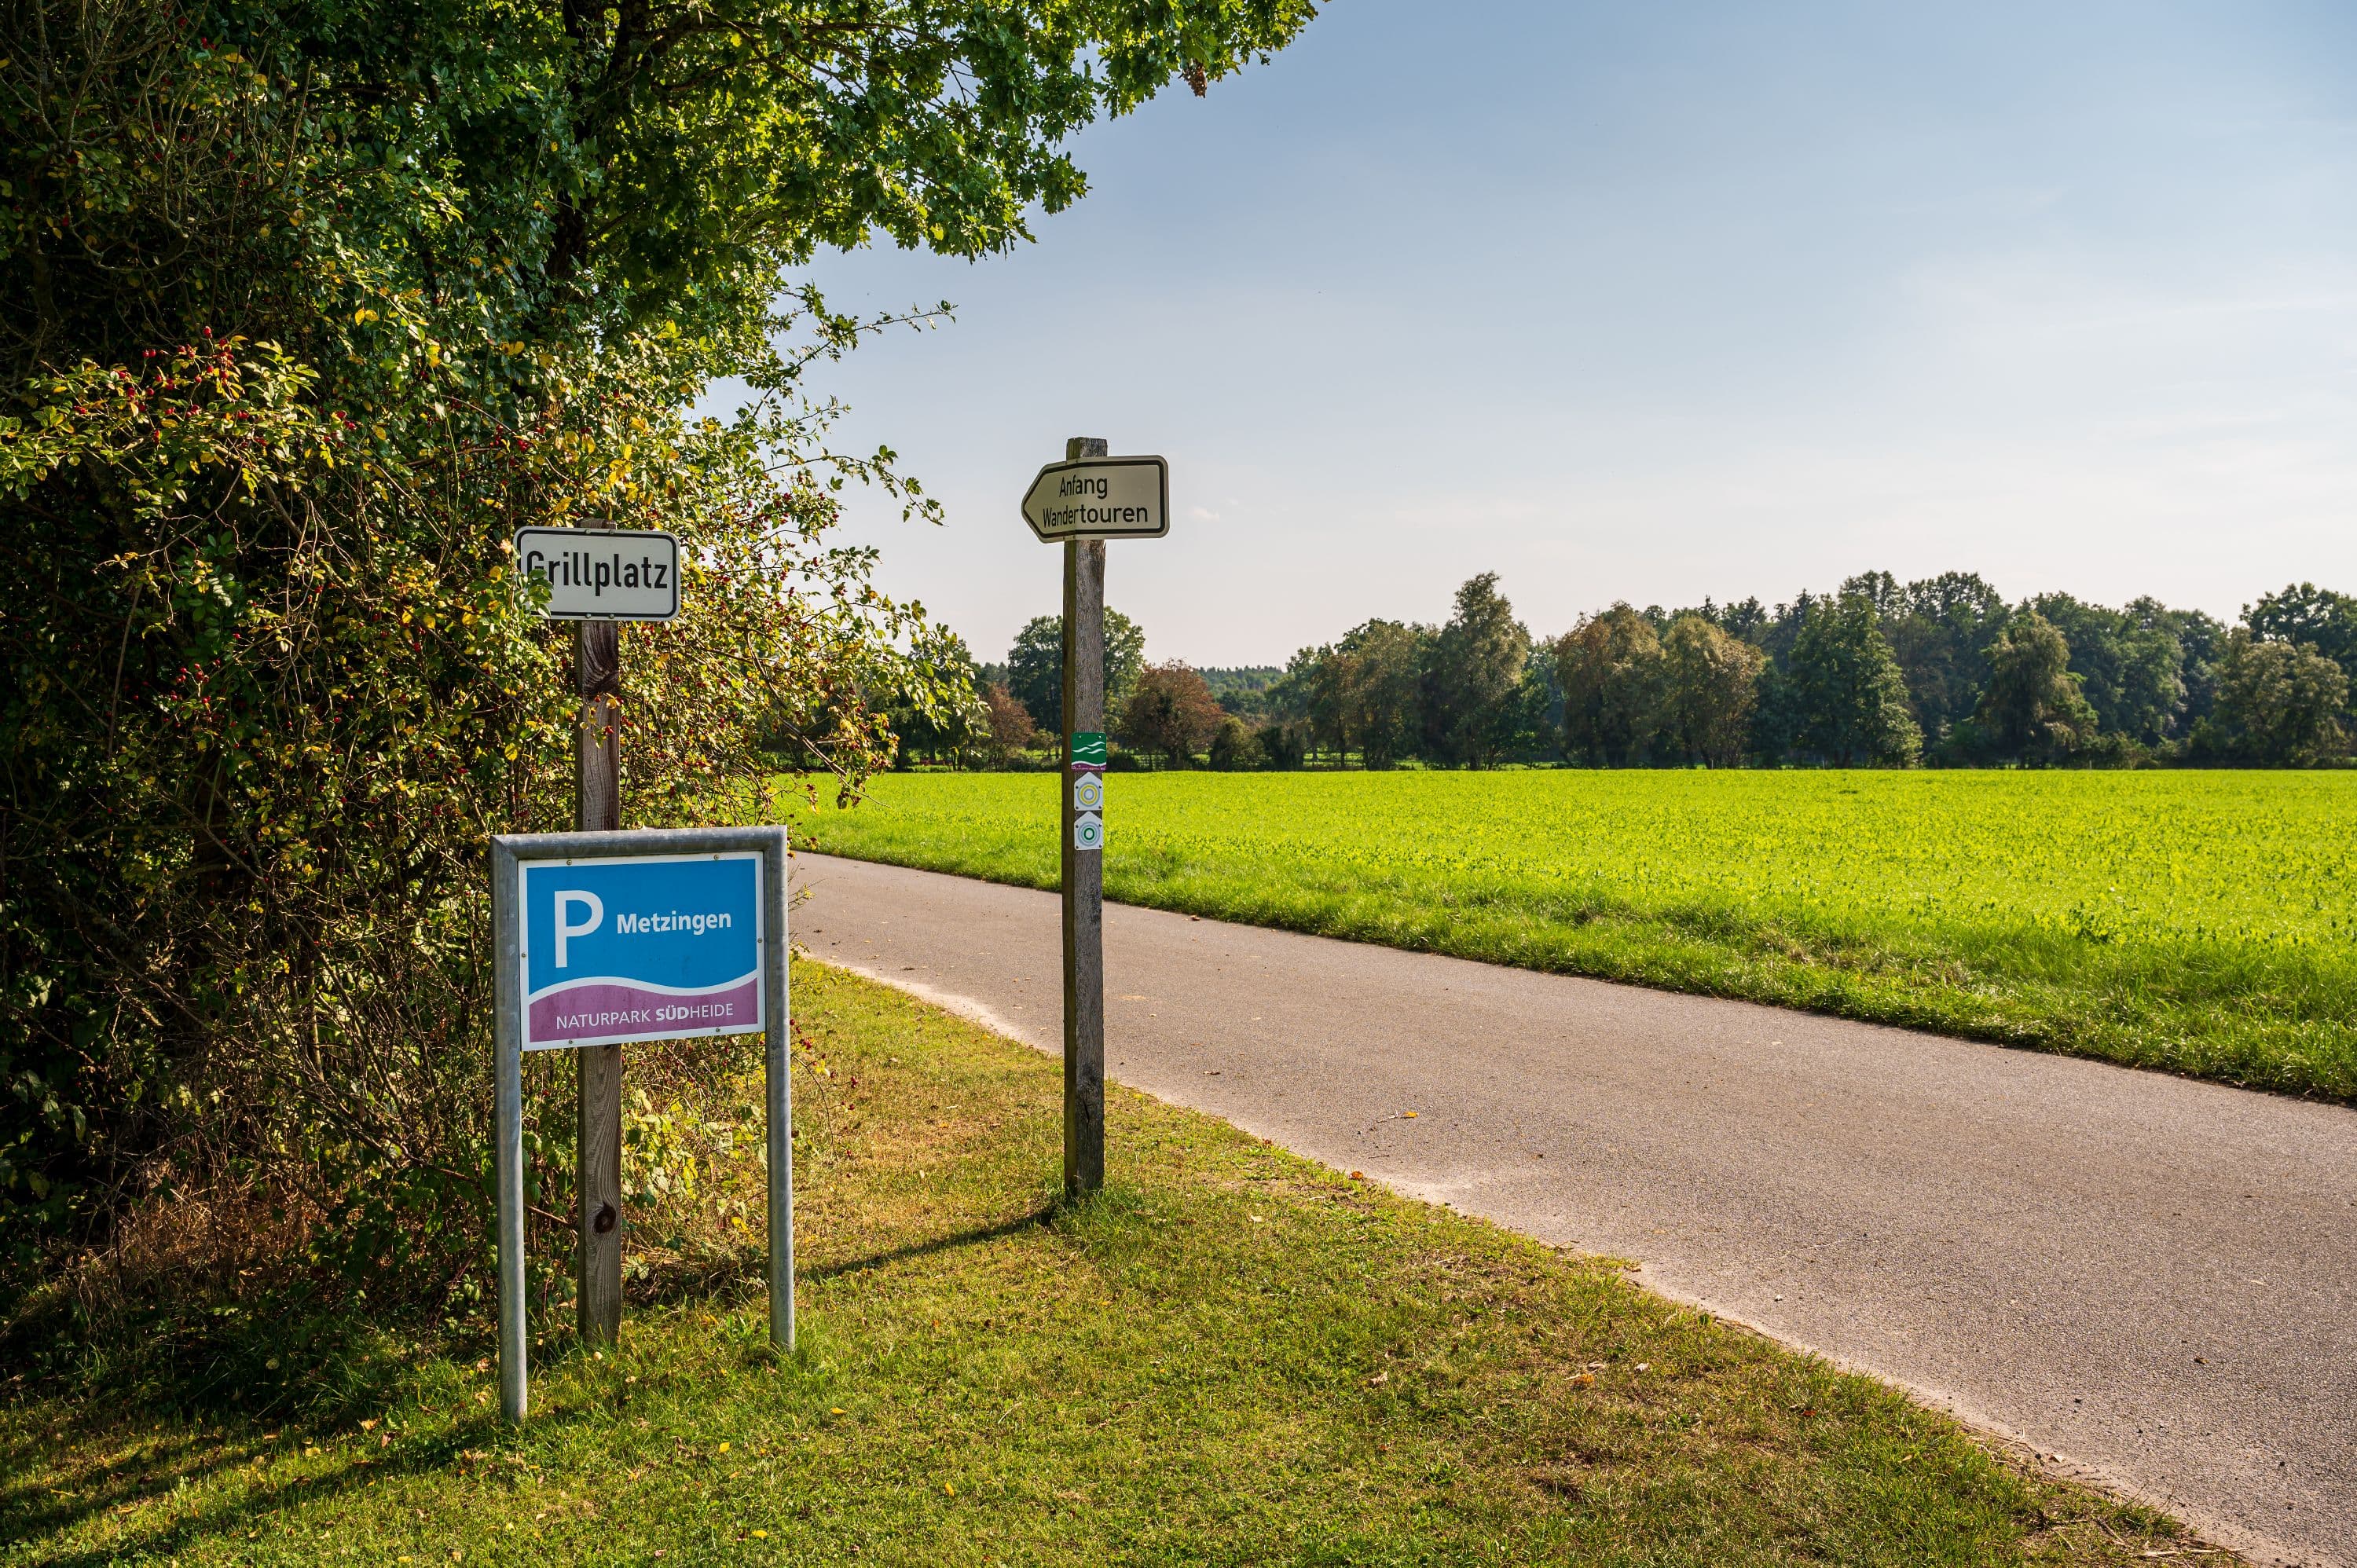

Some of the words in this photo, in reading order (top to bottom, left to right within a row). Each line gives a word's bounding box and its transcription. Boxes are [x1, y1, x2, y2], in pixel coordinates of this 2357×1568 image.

[1059, 474, 1107, 499] Anfang
[1043, 504, 1148, 528] Wandertouren
[527, 551, 668, 596] Grillplatz
[555, 890, 603, 968] P
[617, 910, 731, 936] Metzingen
[556, 1009, 651, 1030] NATURPARK
[655, 1003, 734, 1021] SÜDHEIDE
